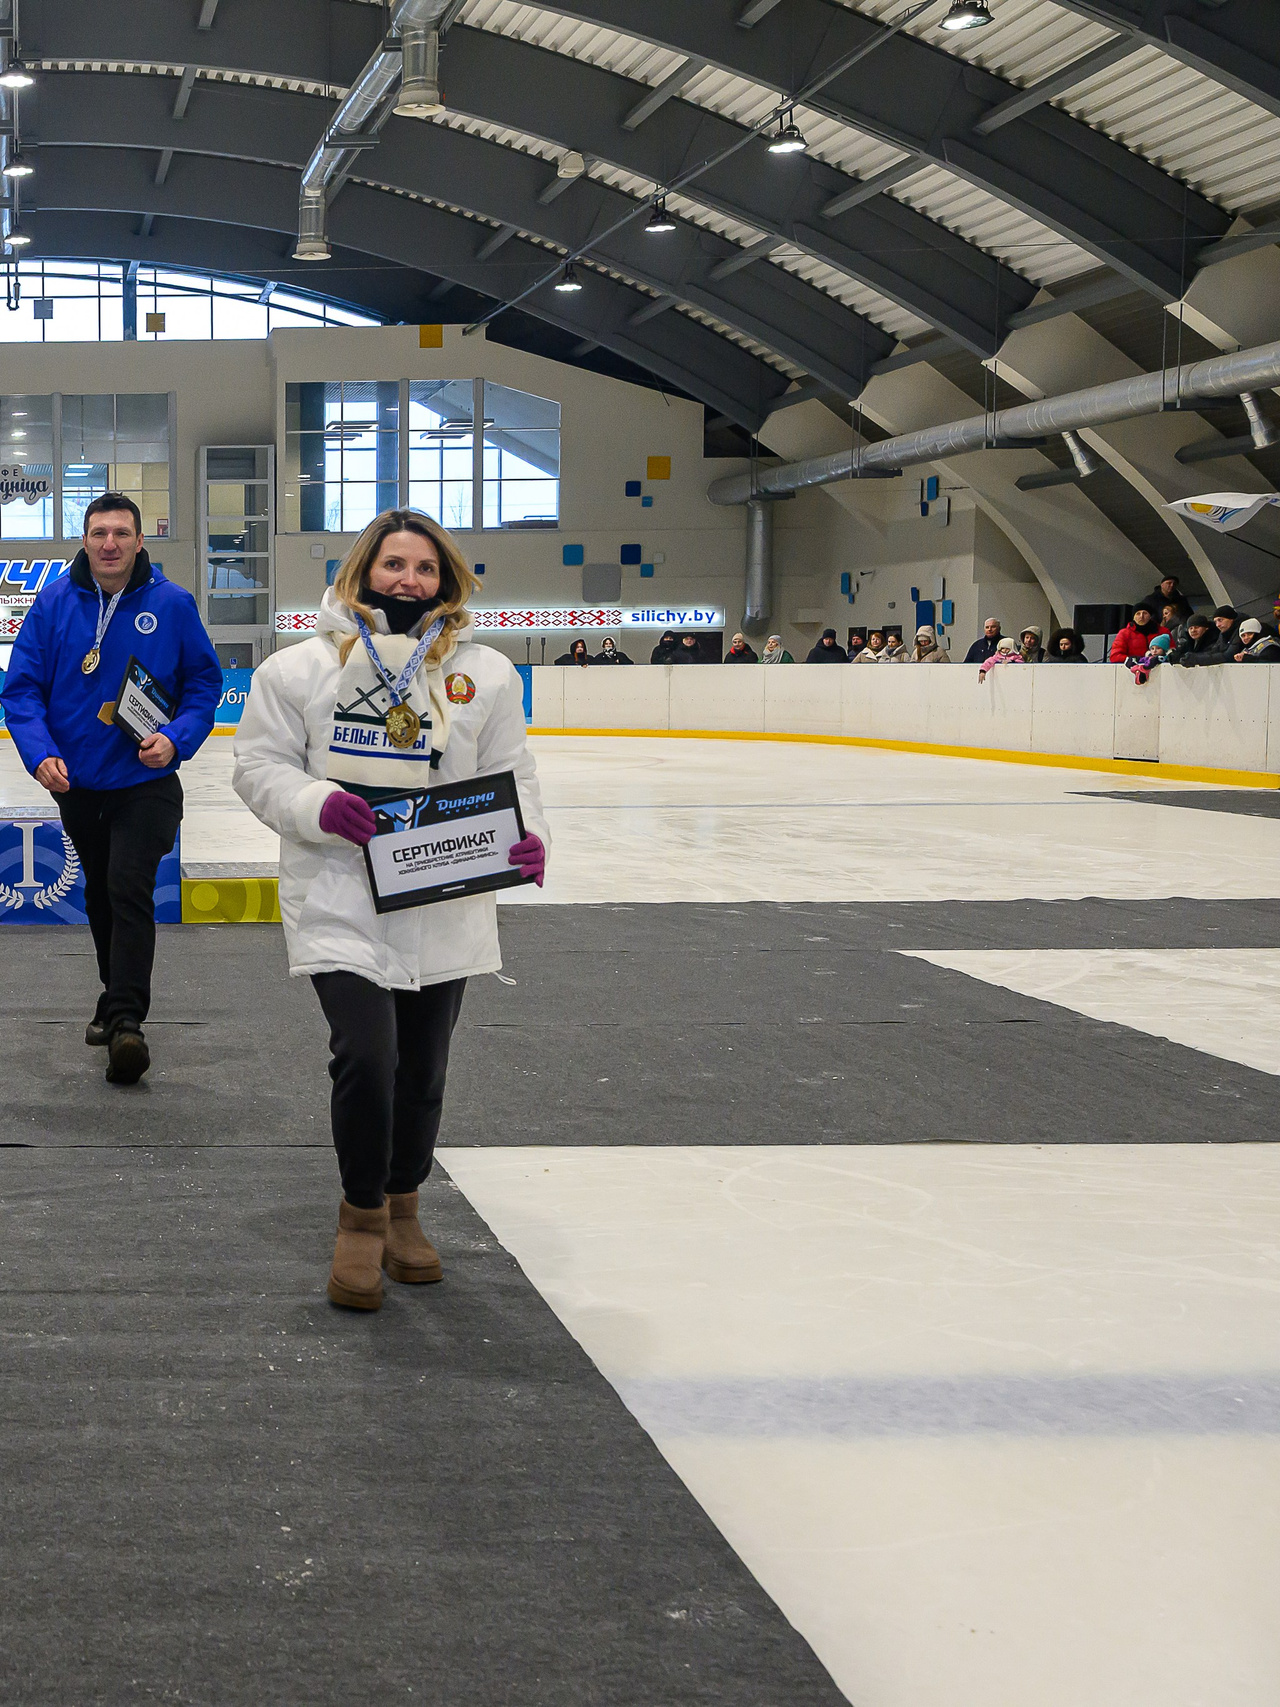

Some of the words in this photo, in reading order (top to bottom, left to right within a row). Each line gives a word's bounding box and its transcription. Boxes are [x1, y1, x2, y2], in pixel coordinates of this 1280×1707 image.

[631, 609, 716, 624] silichy.by
[333, 726, 380, 746] БЕЛЫЕ
[13, 822, 43, 888] I
[392, 829, 496, 863] СЕРТИФИКАТ
